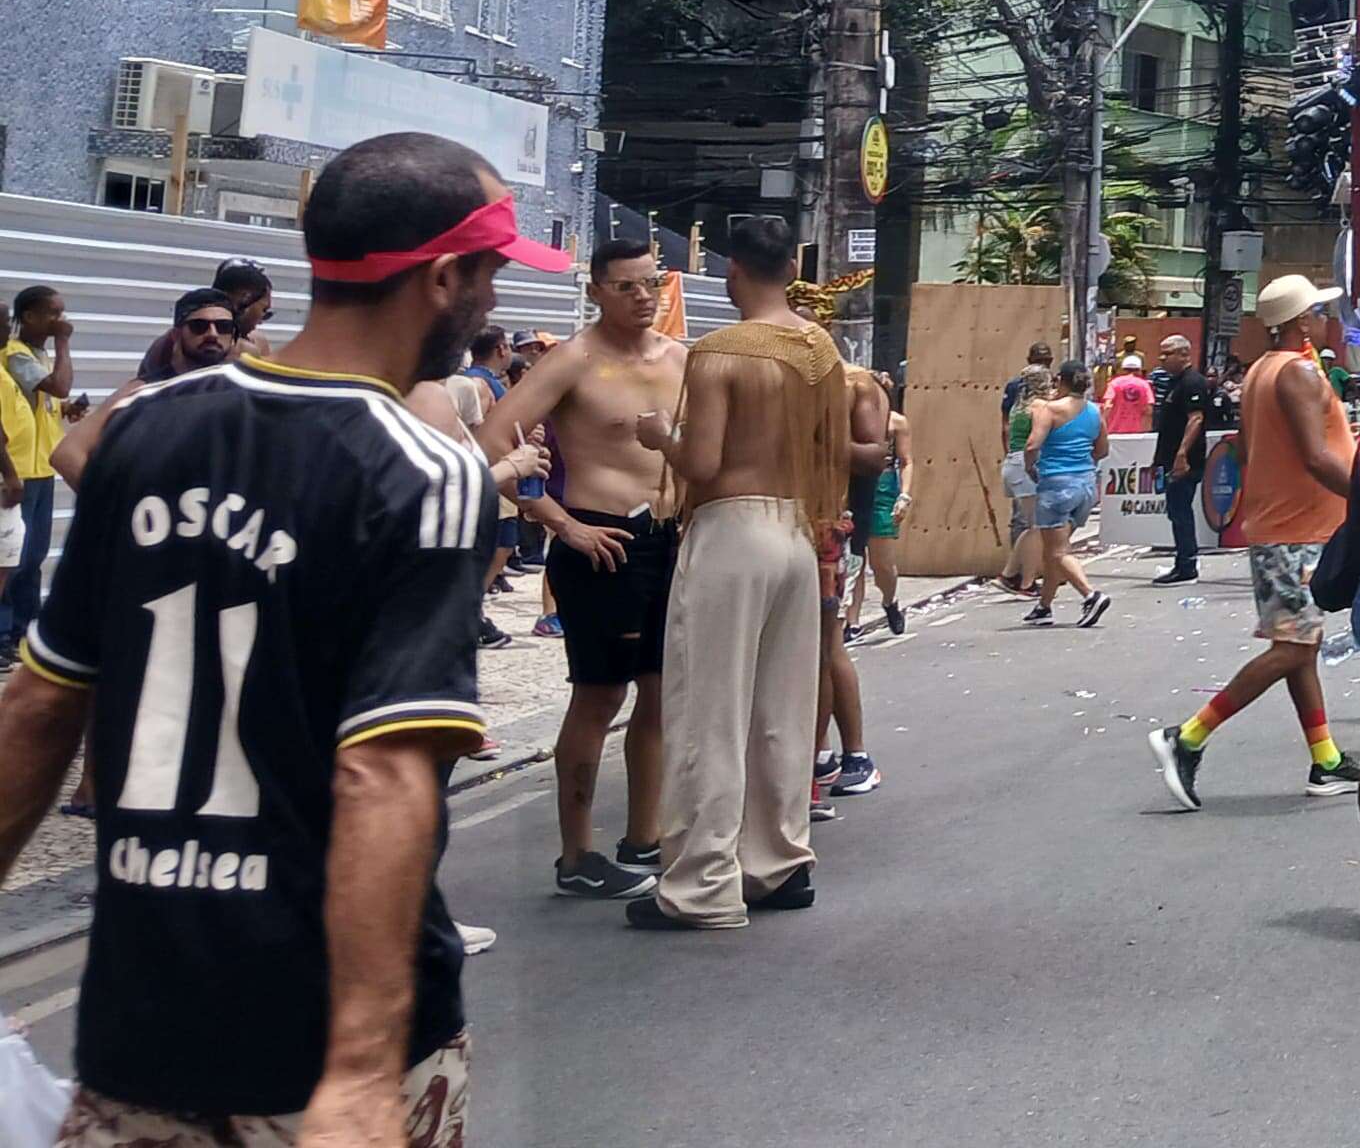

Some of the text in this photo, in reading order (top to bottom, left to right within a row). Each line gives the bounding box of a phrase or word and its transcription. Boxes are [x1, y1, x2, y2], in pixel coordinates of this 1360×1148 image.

[131, 487, 298, 584] OSCAR
[117, 581, 260, 818] 11
[109, 837, 268, 891] Chelsea
